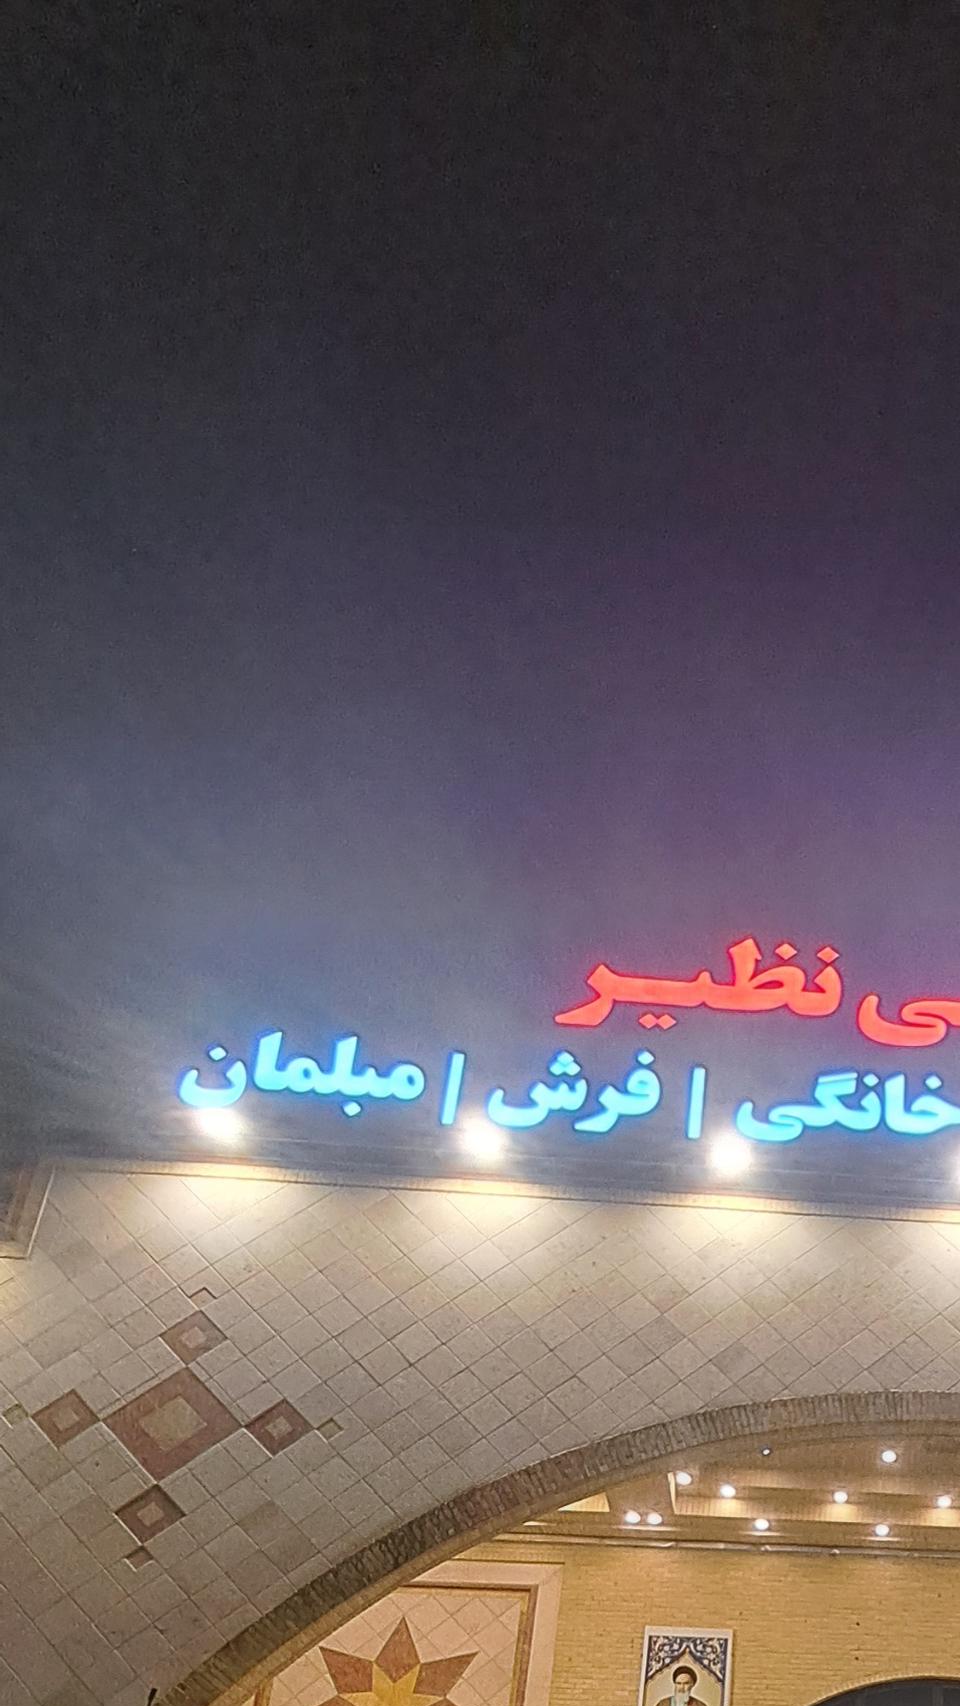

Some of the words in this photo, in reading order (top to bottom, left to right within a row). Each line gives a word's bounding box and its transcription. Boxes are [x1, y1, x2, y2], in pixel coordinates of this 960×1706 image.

[554, 936, 843, 1030] نظیر
[177, 1030, 428, 1118] مبلمان
[486, 1049, 663, 1133] فرش
